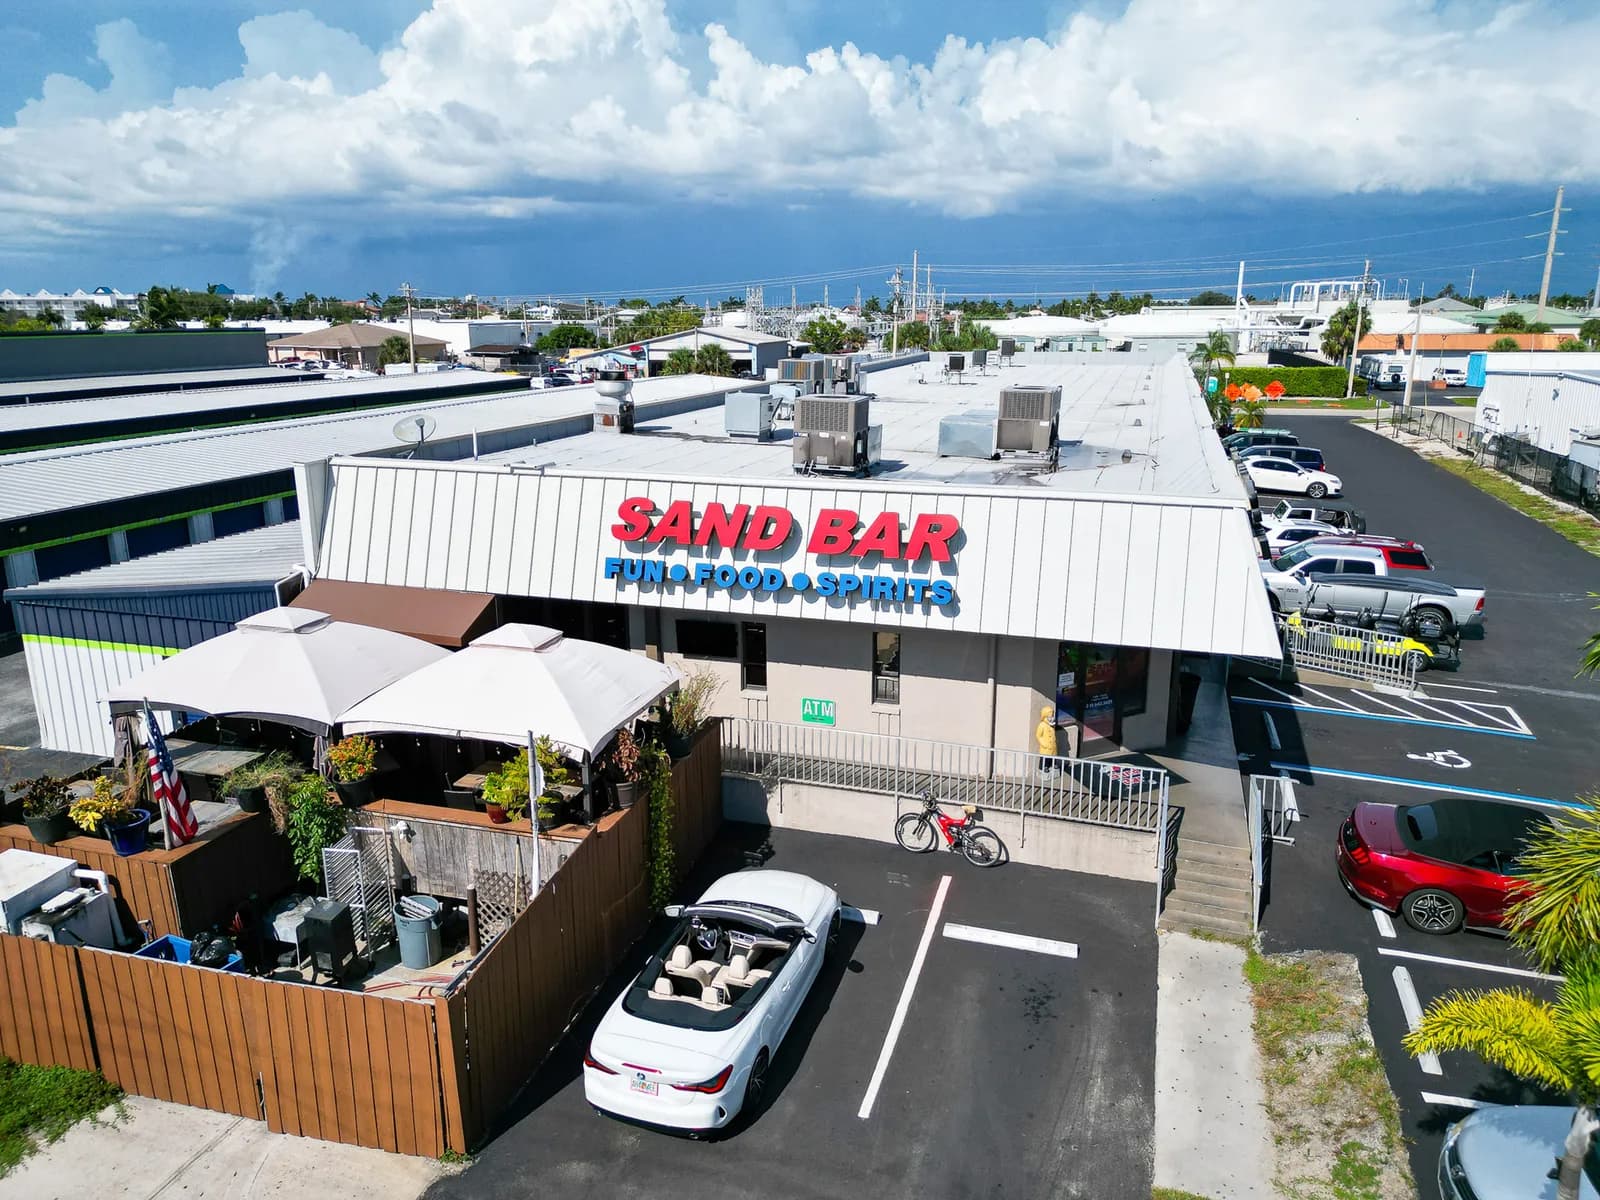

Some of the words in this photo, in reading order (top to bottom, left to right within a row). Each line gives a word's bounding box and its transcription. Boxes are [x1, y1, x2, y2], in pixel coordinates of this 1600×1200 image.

[611, 496, 793, 551] SAND
[806, 509, 959, 564] BAR
[604, 556, 665, 584] FUN
[694, 563, 785, 593] FOOD
[816, 571, 953, 607] SPIRITS
[803, 699, 834, 717] ATM
